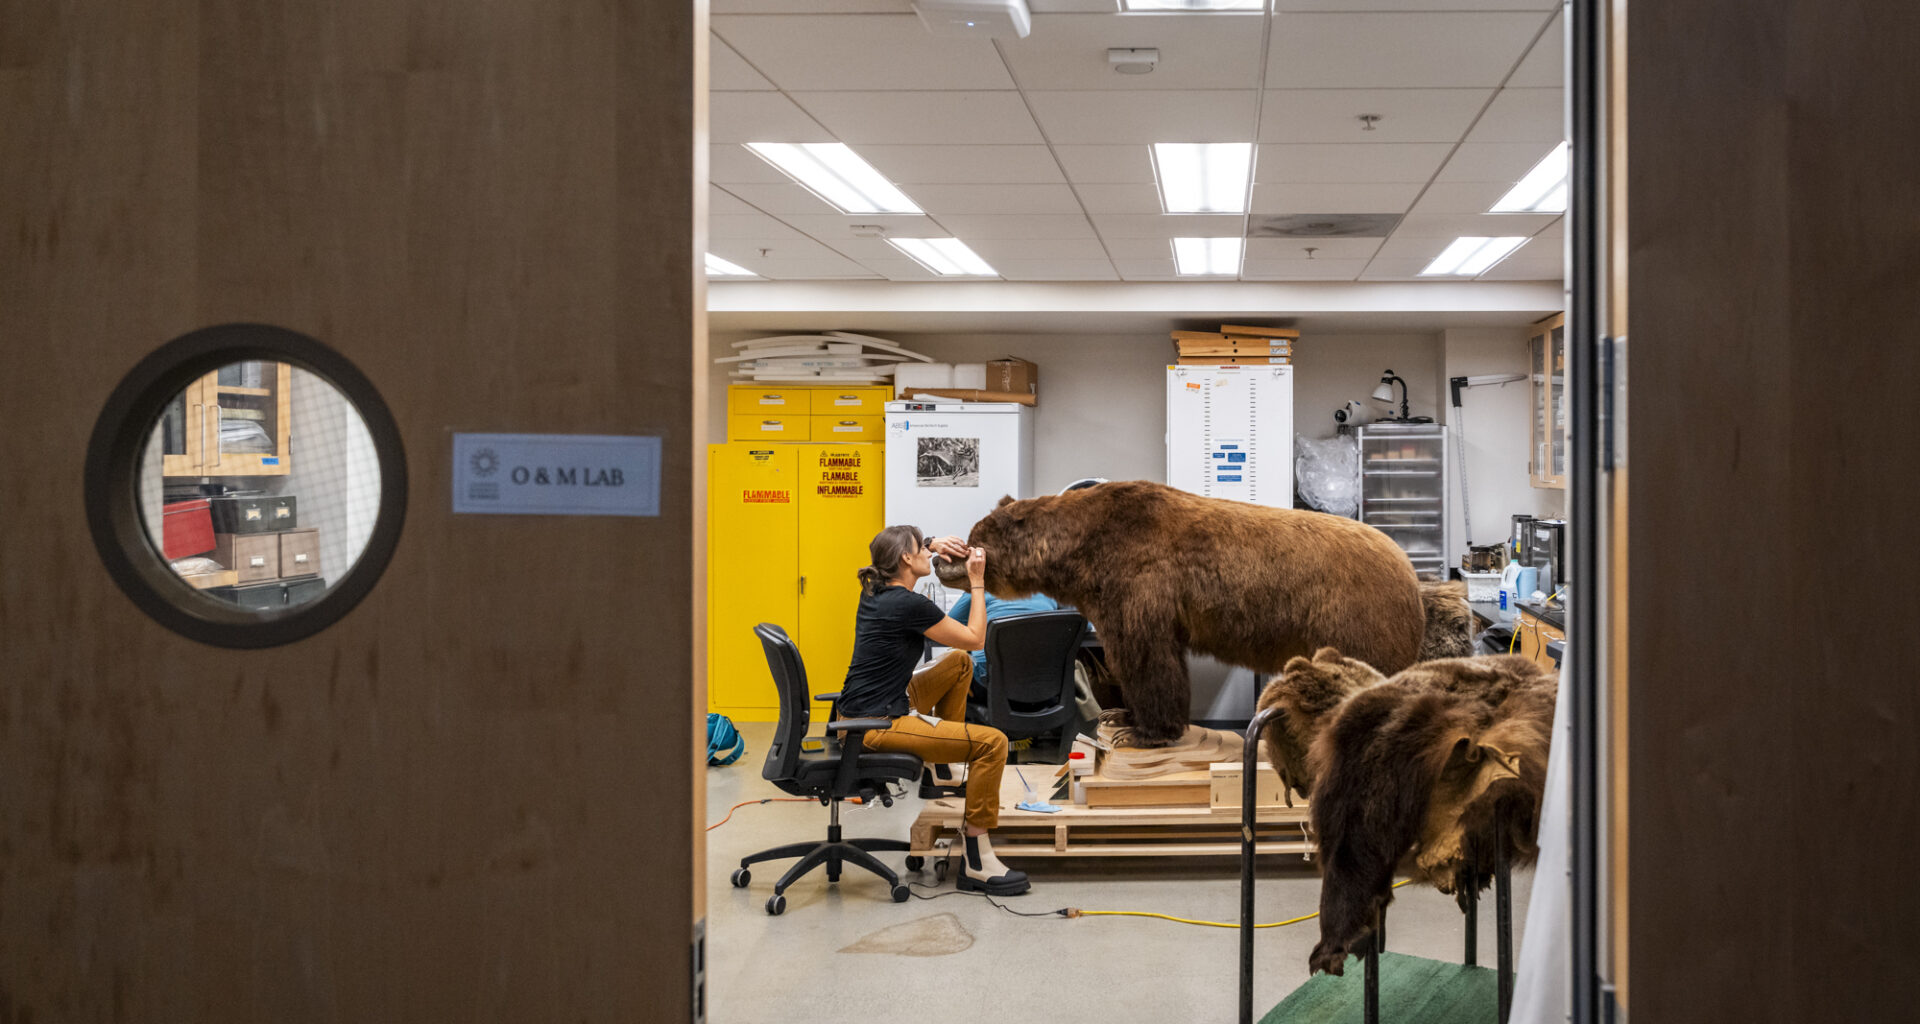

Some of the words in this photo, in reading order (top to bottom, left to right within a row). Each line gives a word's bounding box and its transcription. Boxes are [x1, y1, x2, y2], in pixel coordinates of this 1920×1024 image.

[819, 458, 861, 467] FLAMMABLE
[511, 466, 530, 485] O
[535, 467, 550, 485] &
[556, 468, 576, 486] M
[583, 468, 625, 487] LAB
[822, 471, 858, 481] FLAMABLE
[743, 490, 790, 499] FLAMMABLE
[817, 485, 863, 495] INFLAMMABLE
